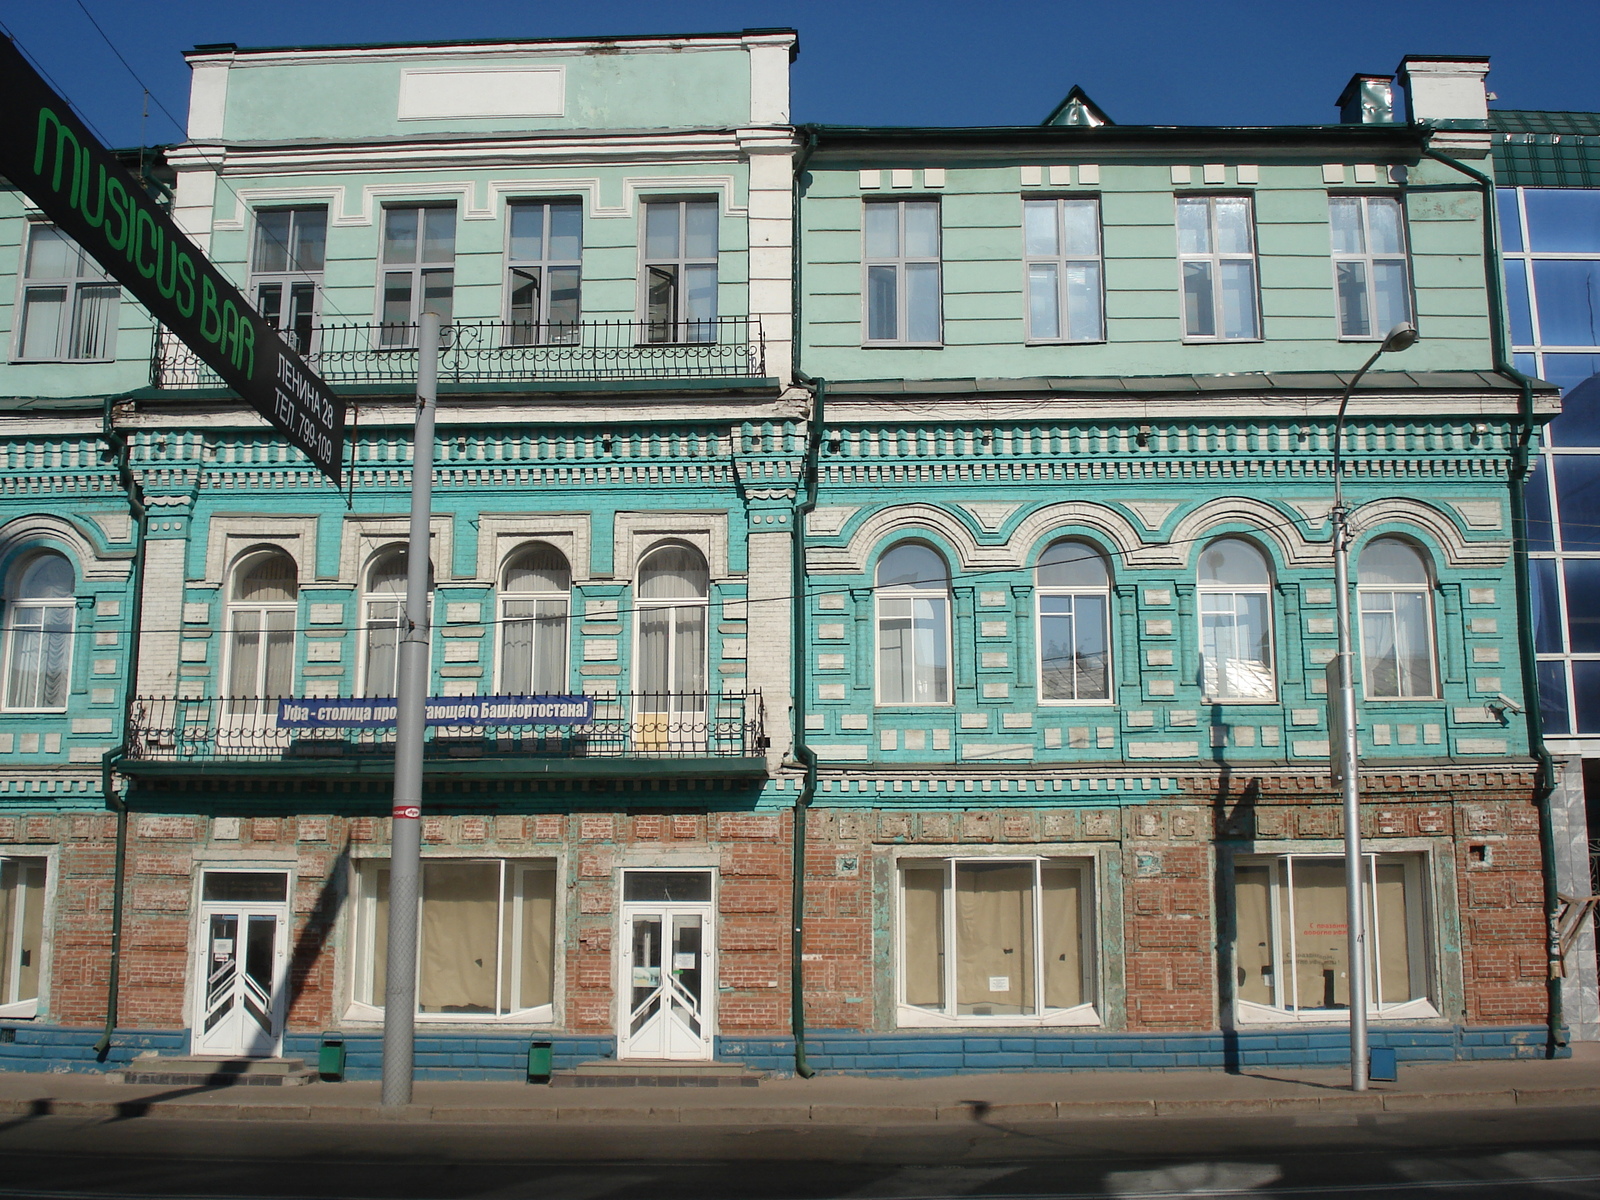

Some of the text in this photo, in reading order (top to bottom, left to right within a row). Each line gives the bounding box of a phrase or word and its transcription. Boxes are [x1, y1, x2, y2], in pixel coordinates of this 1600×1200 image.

[33, 107, 255, 380] MUSICUS BAR
[274, 387, 332, 464] ТЕЛ. 799-109
[277, 352, 334, 430] ЛЕНИНА 28
[283, 704, 309, 722] Уфа
[317, 705, 372, 723] столица
[373, 704, 479, 722] проающего
[480, 701, 588, 720] Башкортостана!
